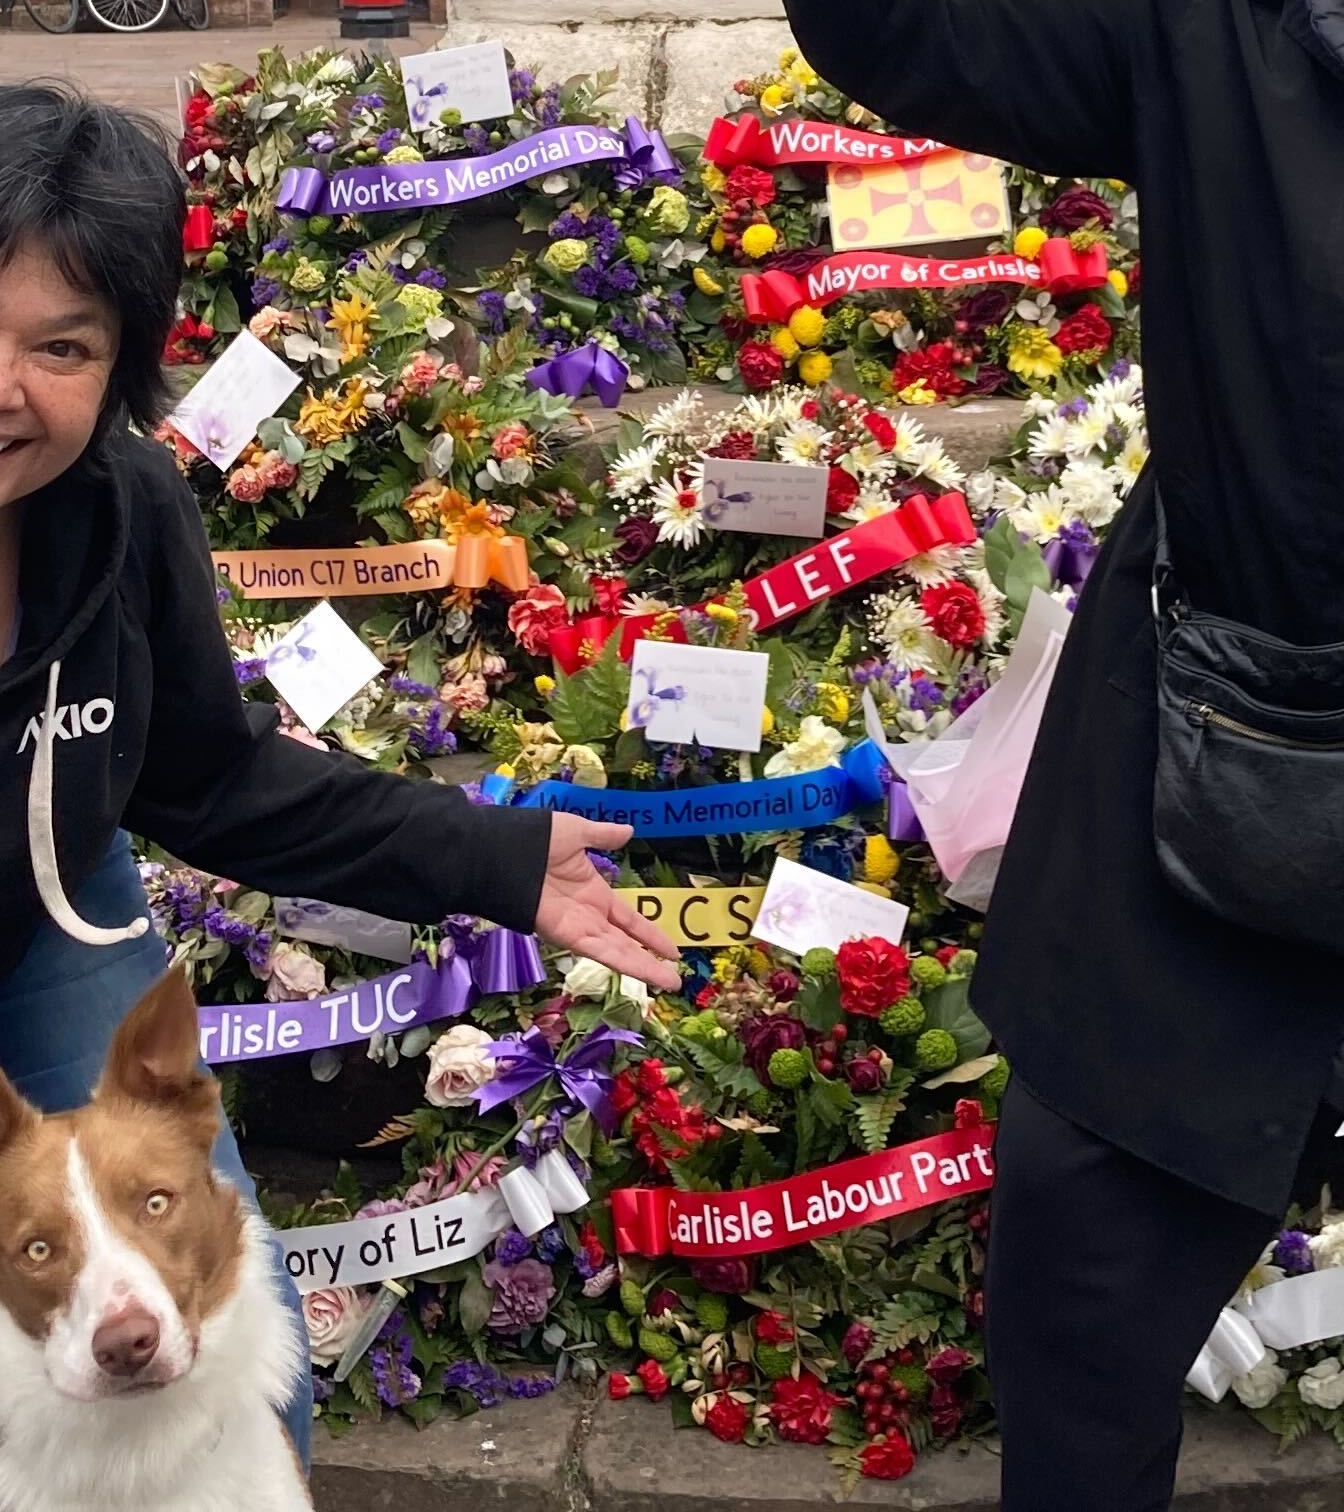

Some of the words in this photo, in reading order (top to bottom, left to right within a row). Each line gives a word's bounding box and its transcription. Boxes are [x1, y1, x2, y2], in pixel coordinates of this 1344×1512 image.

[330, 174, 439, 208] Workers
[446, 135, 570, 203] Memorial
[572, 128, 625, 159] Day
[770, 123, 894, 159] Workers
[807, 263, 891, 300] Mayor
[900, 263, 929, 283] of
[938, 259, 1042, 282] Carlisle
[240, 561, 305, 588] Union
[311, 560, 345, 585] C17
[356, 553, 440, 583] Branch
[738, 537, 856, 629] LEF
[663, 789, 794, 825] Memorial
[802, 783, 842, 813] Day
[200, 1009, 303, 1059] rlisle
[320, 974, 417, 1040] TUC
[668, 1194, 773, 1244] Carlisle
[783, 1171, 904, 1232] Labour
[910, 1143, 993, 1194] Part
[285, 1245, 345, 1285] ory
[359, 1223, 396, 1267] of
[410, 1215, 466, 1256] Liz
